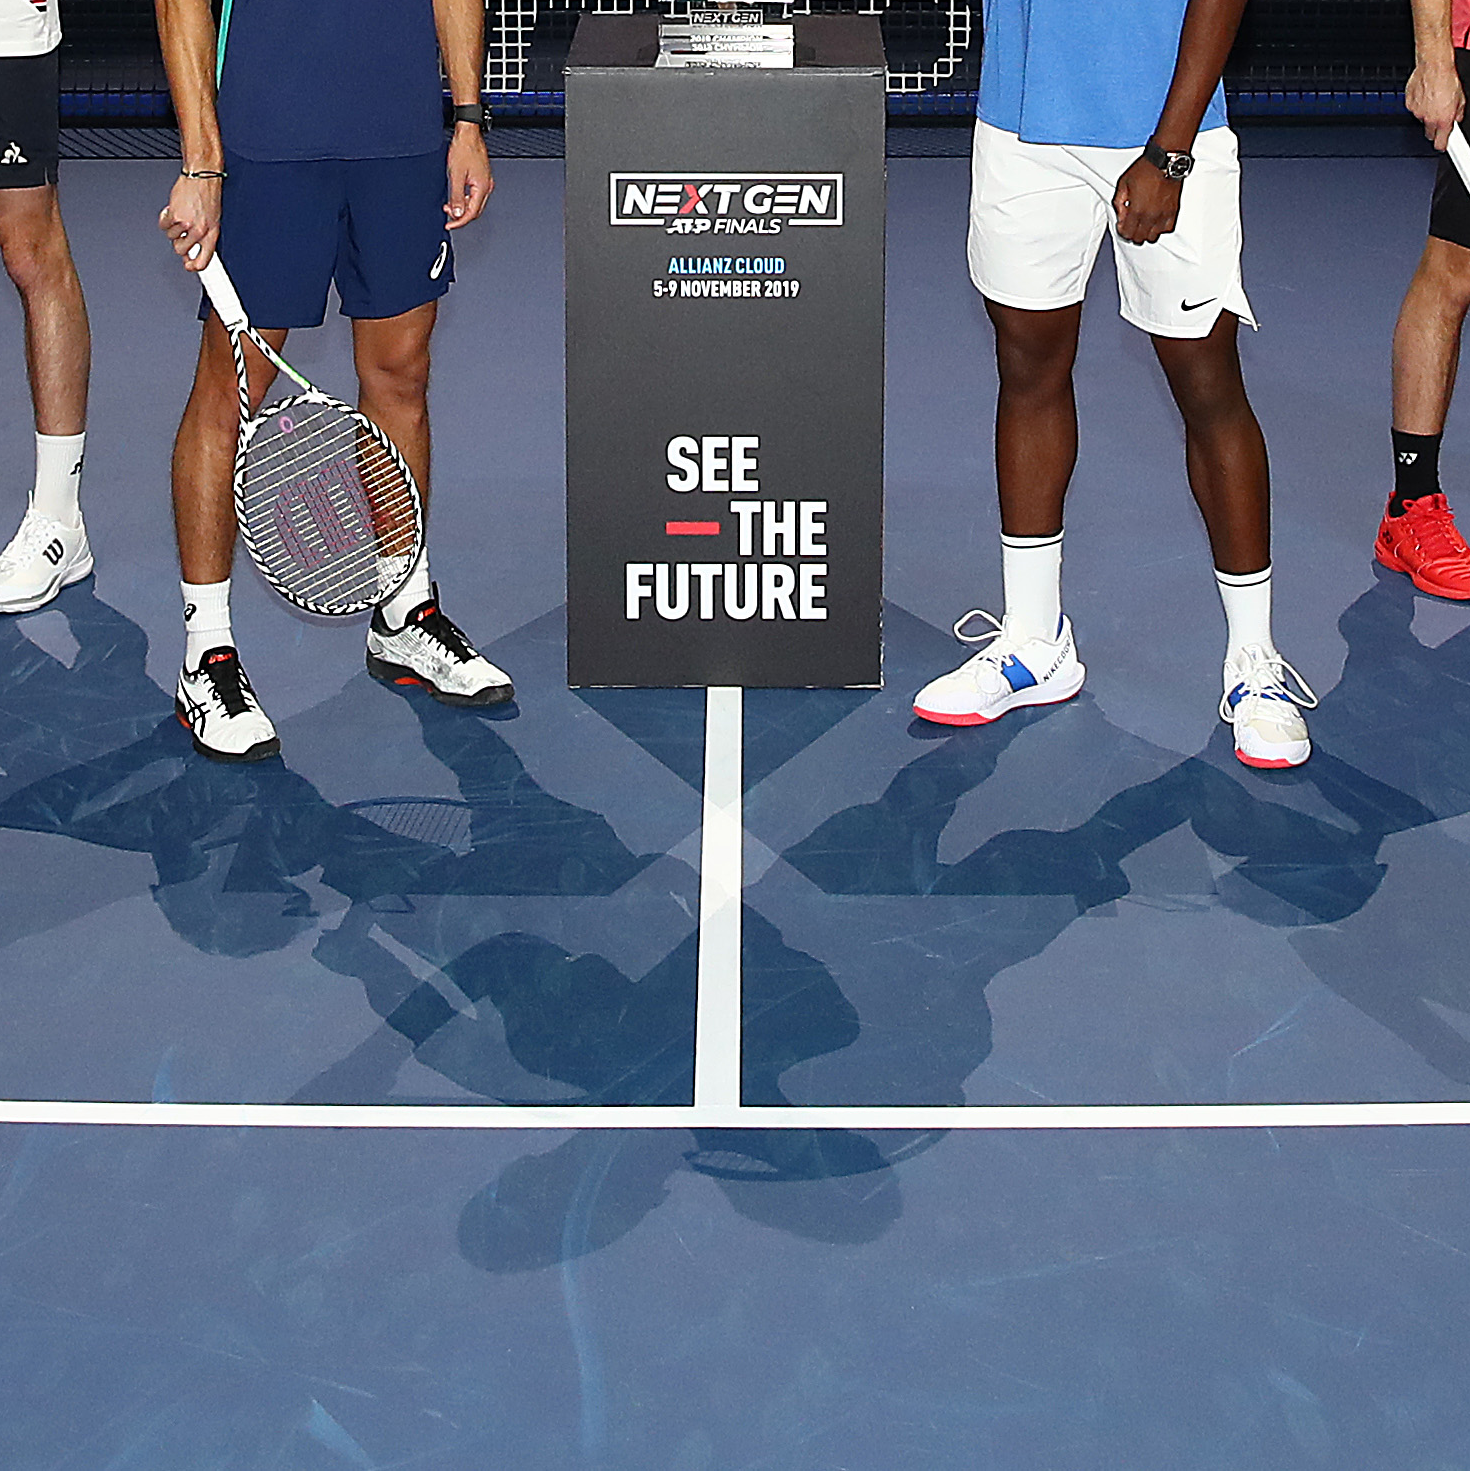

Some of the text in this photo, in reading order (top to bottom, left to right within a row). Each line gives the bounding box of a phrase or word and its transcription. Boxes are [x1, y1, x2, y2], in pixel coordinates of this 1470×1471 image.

[693, 12, 759, 23] NEXT GEN
[621, 183, 832, 216] NEXT GEN
[666, 217, 782, 235] ATP FINALS
[667, 257, 786, 275] ALLIANZ CLOUD
[652, 280, 801, 298] 5-9 NOVEMBER 2019
[665, 434, 761, 494] SEE
[729, 499, 829, 557] THE
[625, 562, 829, 621] FUTURE
